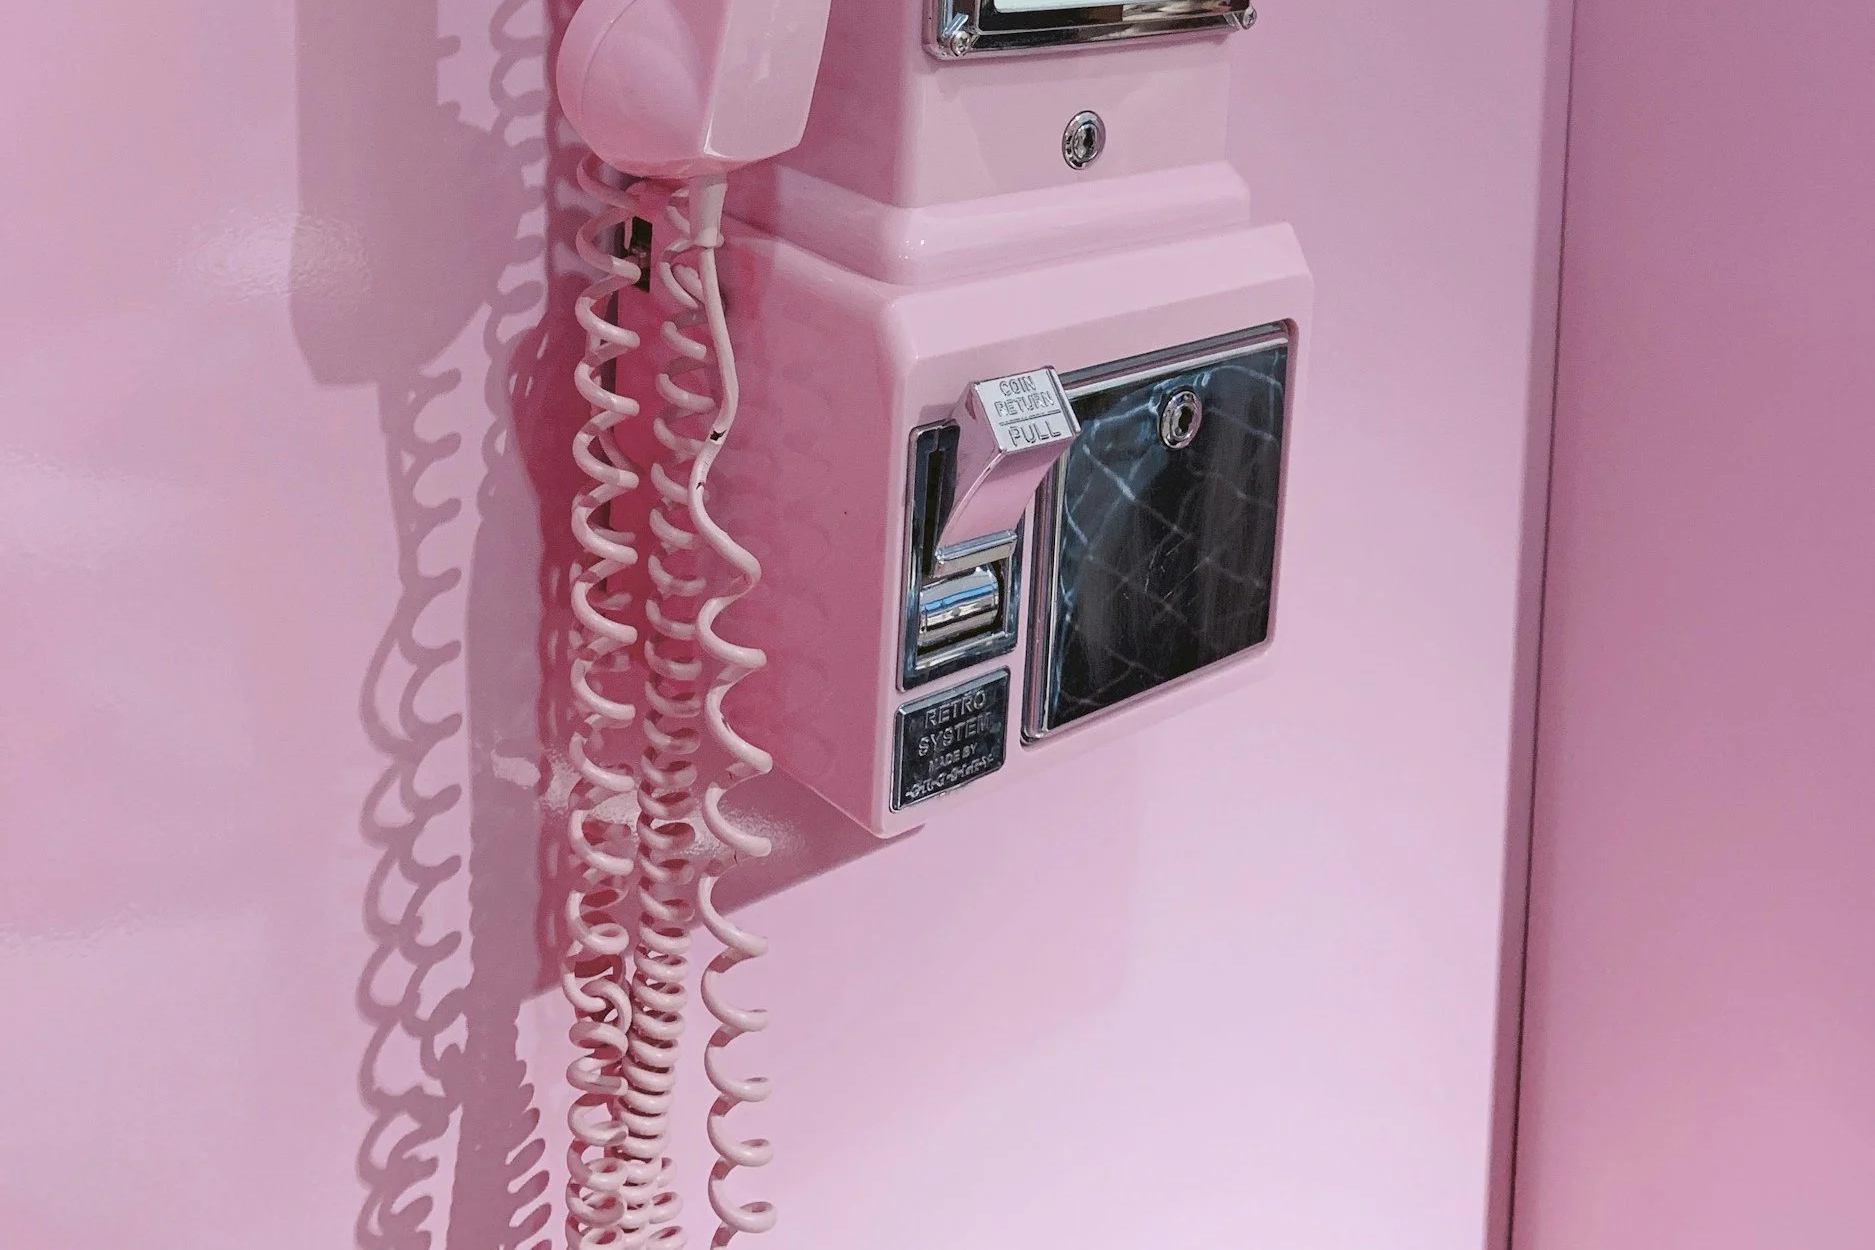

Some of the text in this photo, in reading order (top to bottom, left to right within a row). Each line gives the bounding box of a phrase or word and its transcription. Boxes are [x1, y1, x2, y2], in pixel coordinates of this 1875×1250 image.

[999, 375, 1036, 397] COIN
[993, 390, 1055, 417] RETURN
[1008, 420, 1062, 447] PULL
[924, 690, 987, 729] RETRO
[918, 711, 992, 757] SYSTEM
[962, 741, 978, 759] BY
